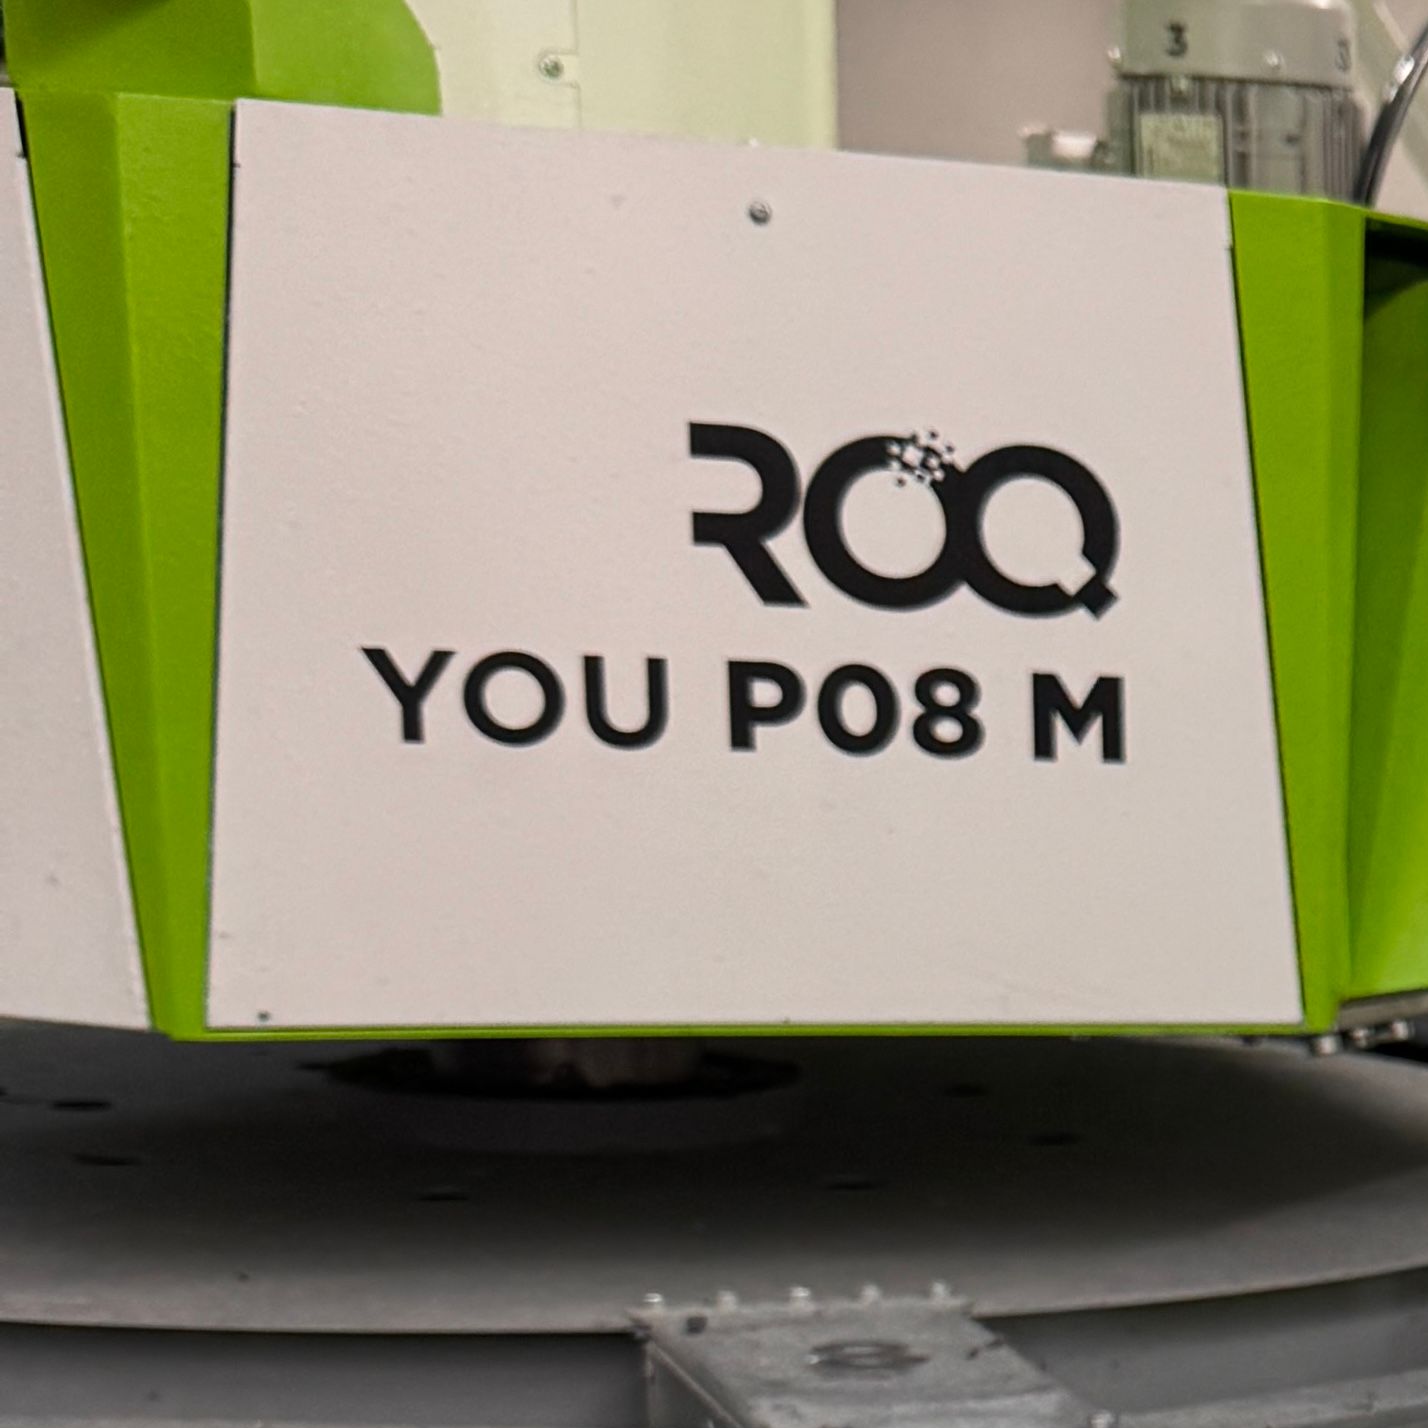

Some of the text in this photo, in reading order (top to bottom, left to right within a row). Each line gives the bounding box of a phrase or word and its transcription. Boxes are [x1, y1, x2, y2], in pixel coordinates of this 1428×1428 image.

[1166, 20, 1188, 57] 3
[687, 422, 1121, 619] ROQ
[361, 646, 1128, 766] YOU P08 M
